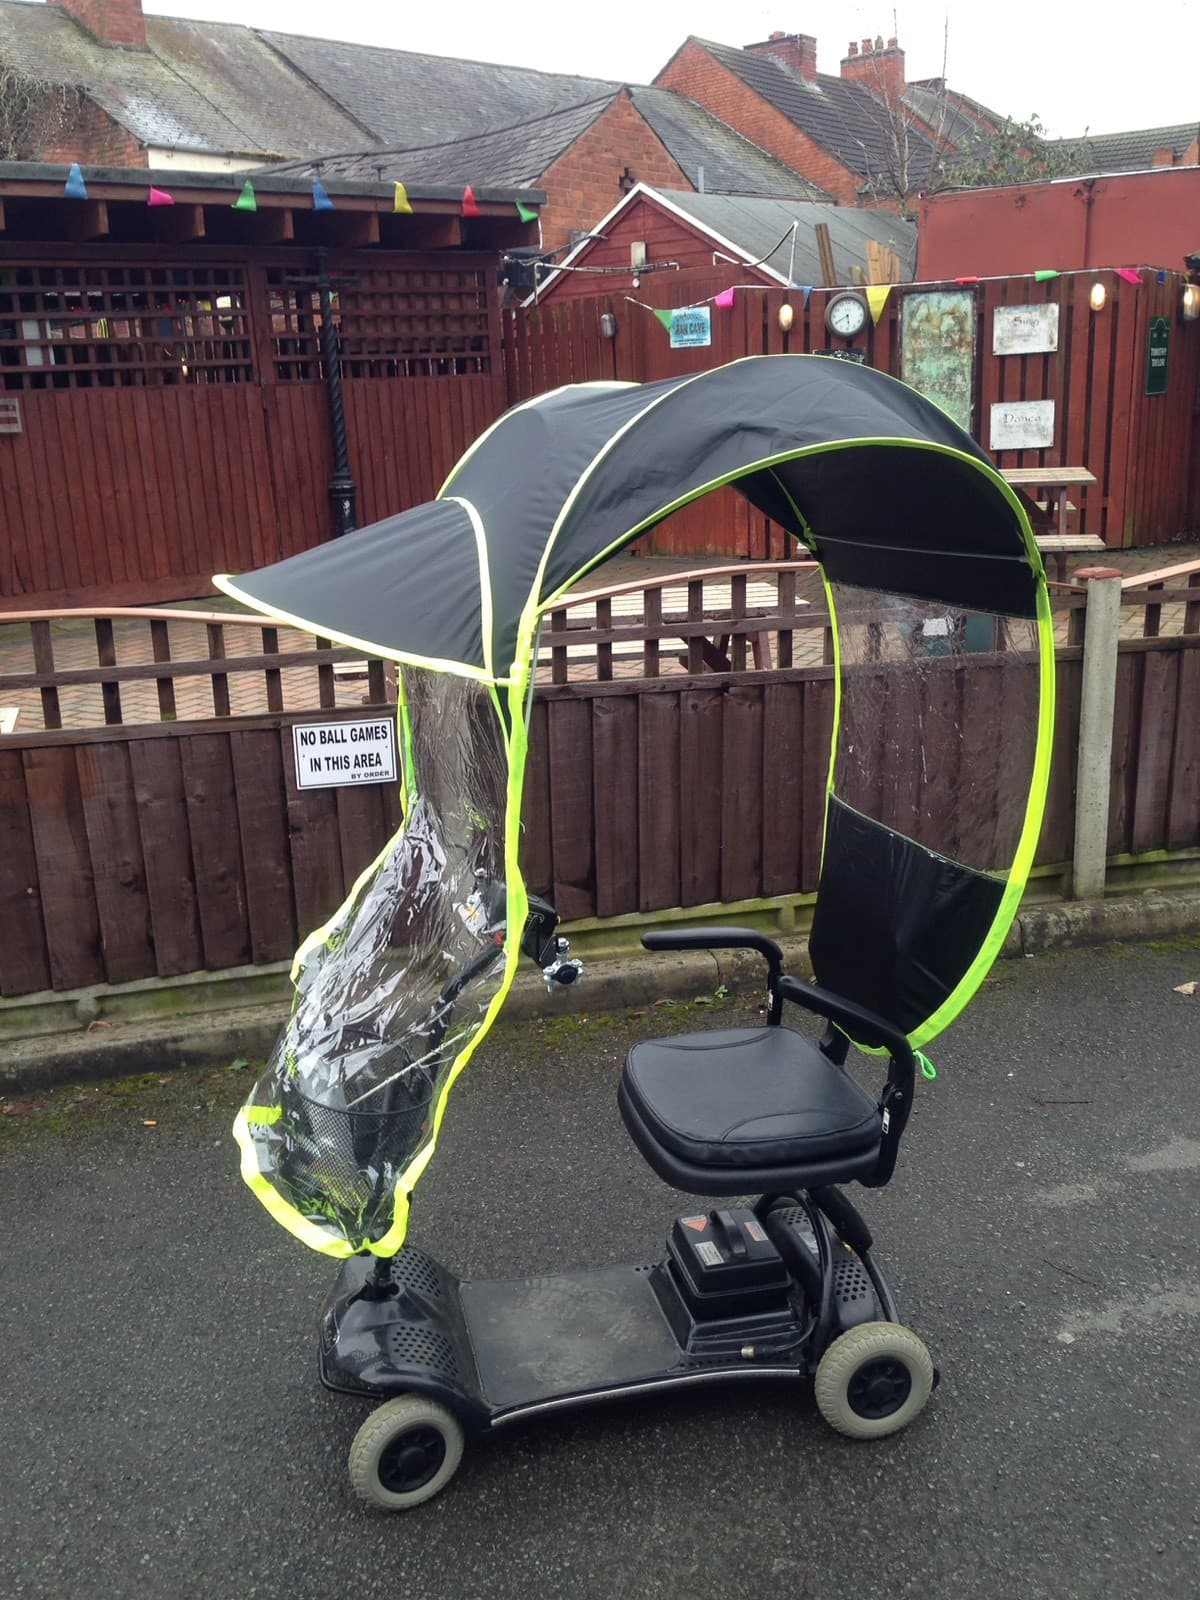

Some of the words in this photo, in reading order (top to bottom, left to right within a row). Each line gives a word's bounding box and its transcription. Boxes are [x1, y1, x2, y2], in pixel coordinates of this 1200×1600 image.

[300, 731, 316, 746] NO
[319, 729, 347, 744] BALL
[350, 725, 388, 742] GAMES
[310, 757, 321, 772] IN
[324, 755, 350, 771] THIS
[353, 752, 382, 768] AREA
[363, 770, 390, 778] ORDER
